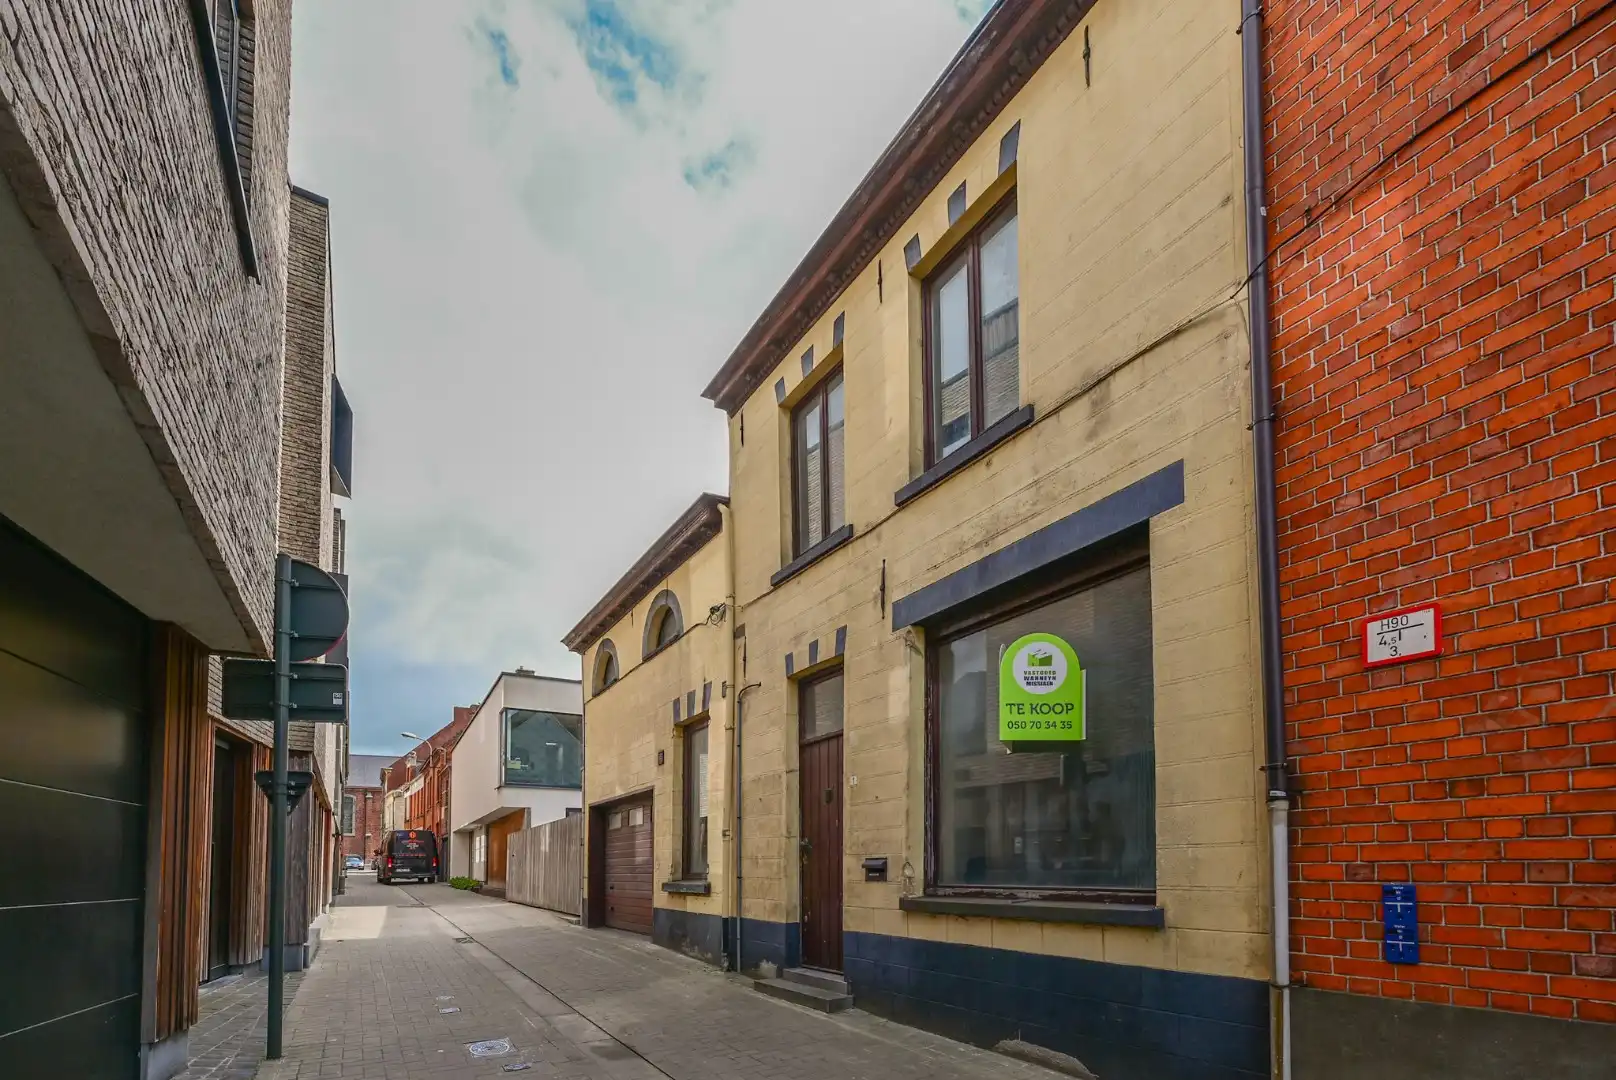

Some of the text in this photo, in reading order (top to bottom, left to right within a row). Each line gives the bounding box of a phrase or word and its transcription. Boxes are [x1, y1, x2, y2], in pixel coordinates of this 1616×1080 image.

[1381, 615, 1409, 631] H90
[1006, 703, 1074, 715] TE KOOP
[1007, 721, 1072, 730] 050 70 34 35
